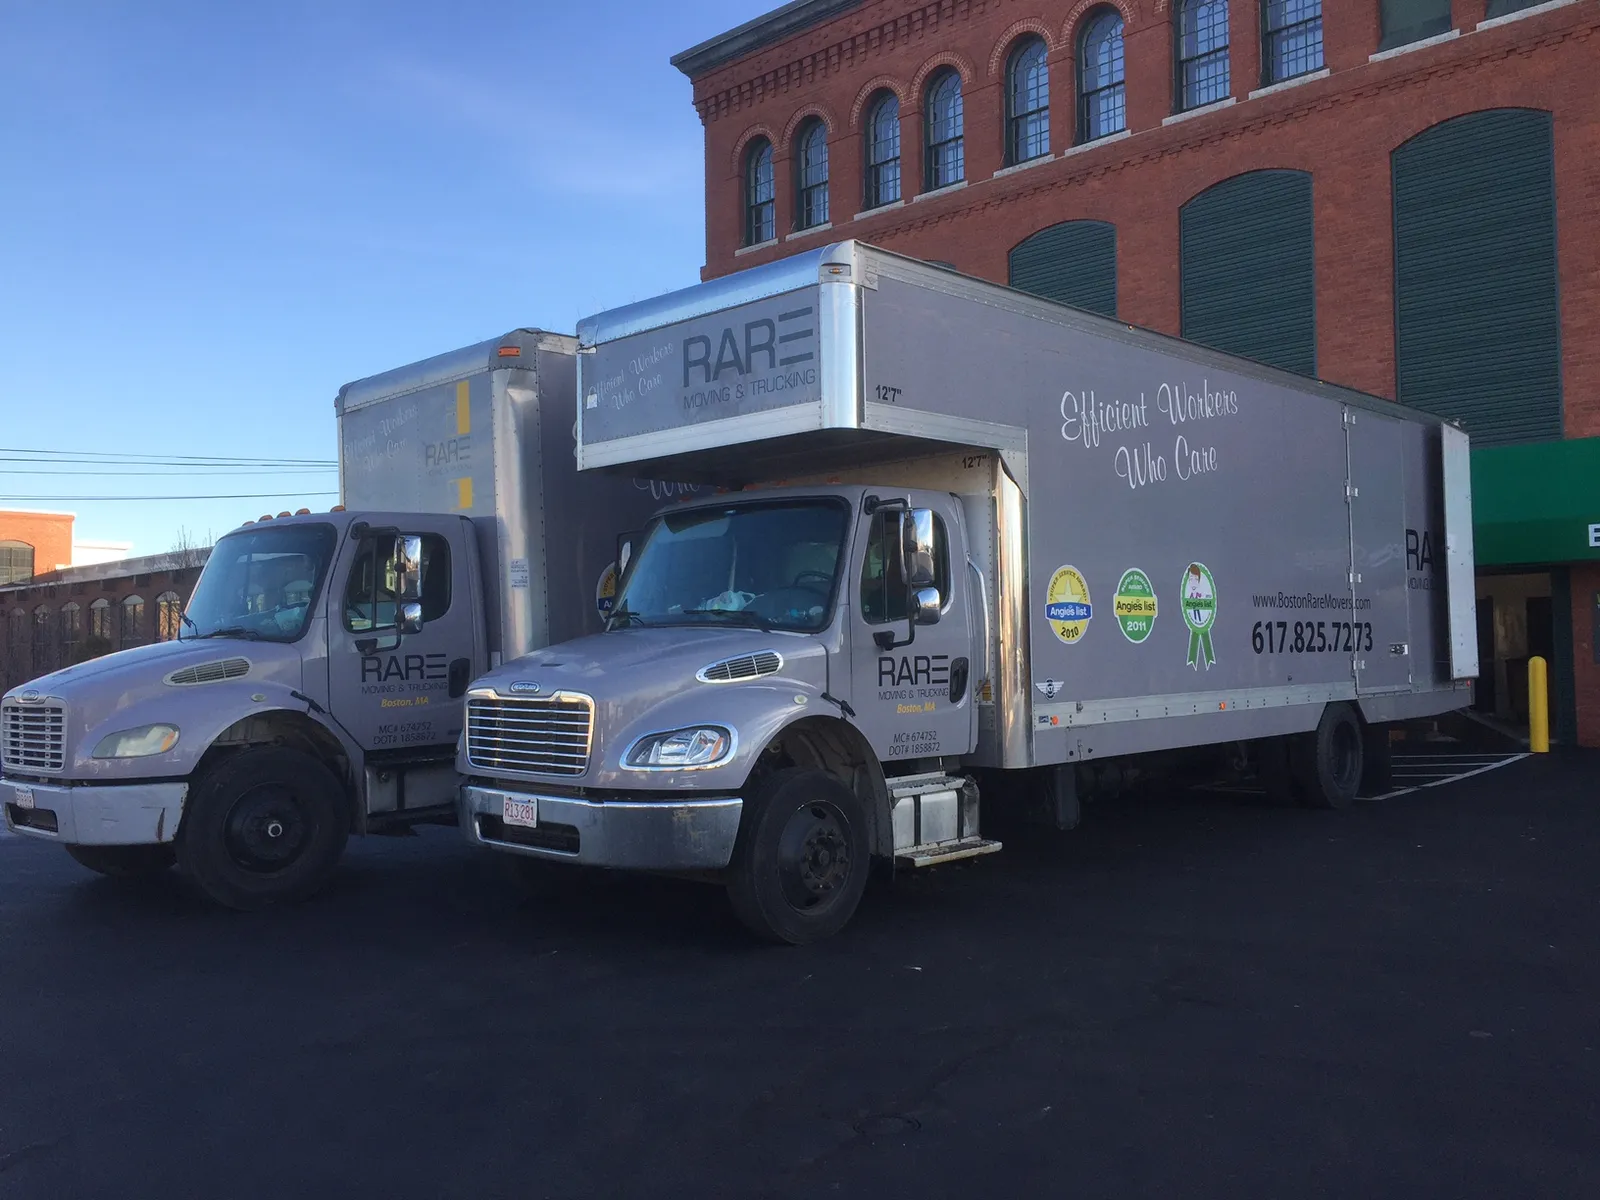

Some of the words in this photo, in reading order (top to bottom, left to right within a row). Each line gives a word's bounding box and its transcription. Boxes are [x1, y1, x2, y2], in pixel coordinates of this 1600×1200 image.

[683, 306, 814, 388] RARE
[588, 369, 625, 404] fficient
[629, 343, 674, 375] Workers
[683, 387, 731, 410] MOVING
[736, 384, 745, 399] &
[750, 369, 816, 395] TRUCKING
[875, 384, 902, 402] 12'7"
[1060, 390, 1150, 448] Efficient
[1157, 379, 1239, 425] Workers
[424, 436, 471, 468] RARE
[1114, 442, 1167, 489] Who
[1175, 435, 1218, 481] Care
[1143, 601, 1156, 611] list
[1252, 592, 1371, 609] www.BostonRareMovers.com
[1075, 606, 1088, 616] list
[1061, 626, 1080, 638] 2010
[1126, 621, 1147, 632] 2011
[1252, 621, 1373, 654] 617.825.7273
[361, 654, 447, 682] RARE
[878, 655, 949, 687] RARE
[361, 684, 396, 695] MOVING
[398, 684, 405, 693] &
[879, 690, 907, 700] MOVING
[909, 690, 914, 698] &
[917, 688, 949, 698] TRUCKING
[381, 698, 413, 708] Boston,
[415, 696, 429, 705] MA
[897, 703, 922, 713] Boston,
[924, 702, 936, 711] MA
[379, 724, 398, 734] MC#
[373, 735, 397, 745] DOT#
[893, 732, 910, 743] MC#
[911, 730, 937, 741] 674752
[888, 745, 909, 756] DOT#
[911, 742, 940, 753] 1858872
